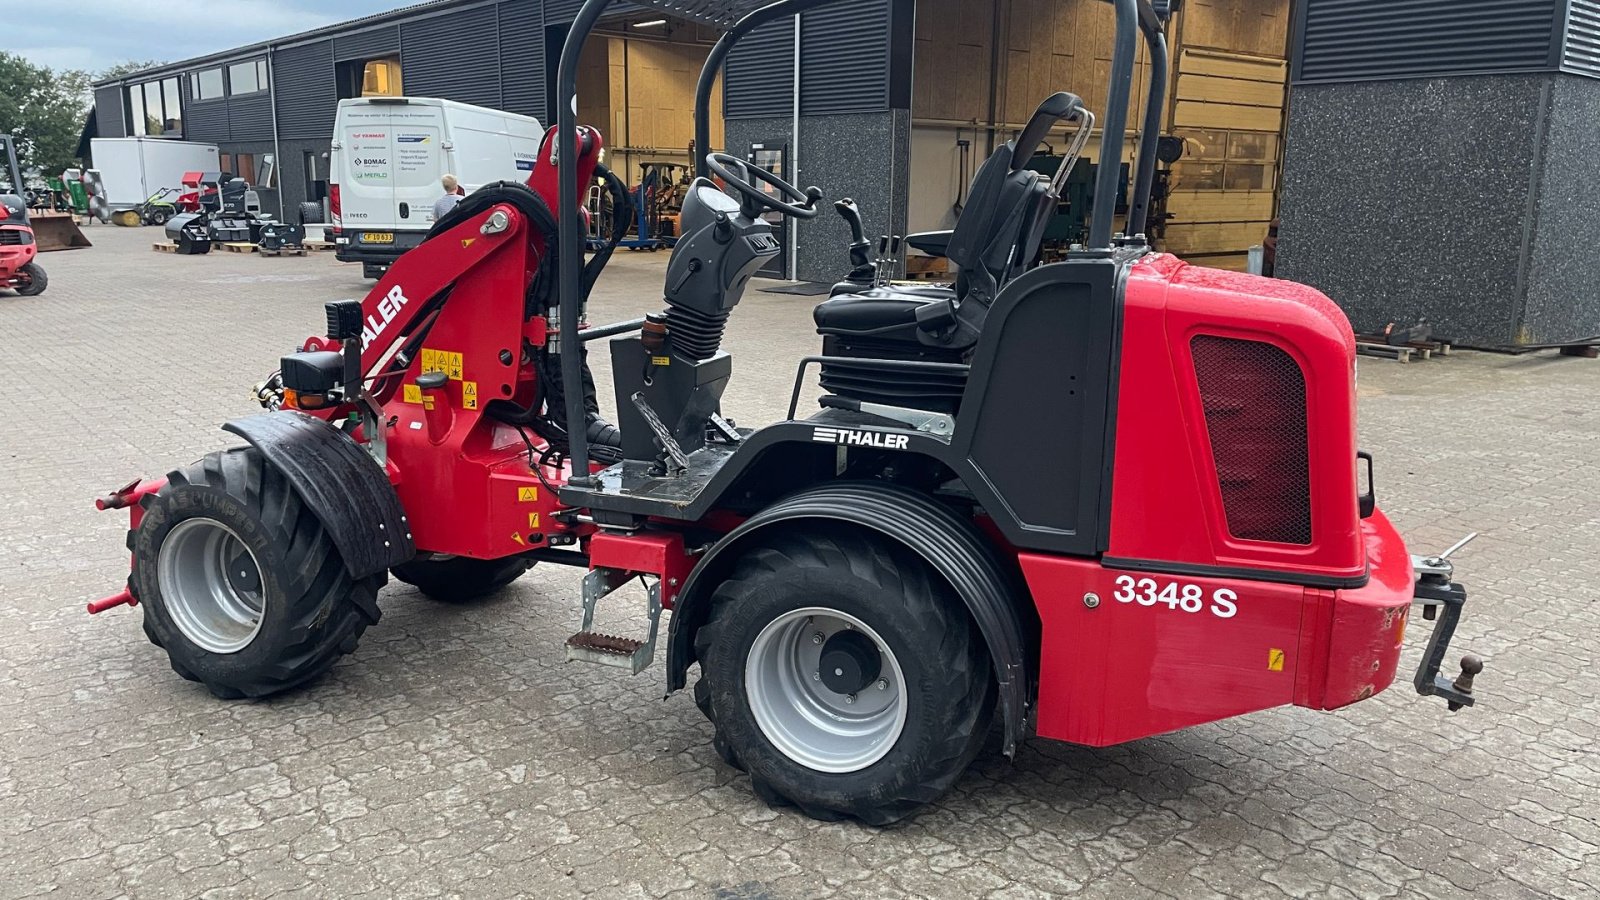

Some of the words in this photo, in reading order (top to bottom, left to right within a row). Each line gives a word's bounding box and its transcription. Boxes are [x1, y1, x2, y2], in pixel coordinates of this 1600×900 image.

[363, 233, 372, 241] CF
[381, 233, 393, 241] 633
[361, 284, 409, 352] ALER
[837, 429, 910, 449] THALER
[1113, 574, 1203, 613] 3348
[1210, 587, 1238, 618] S
